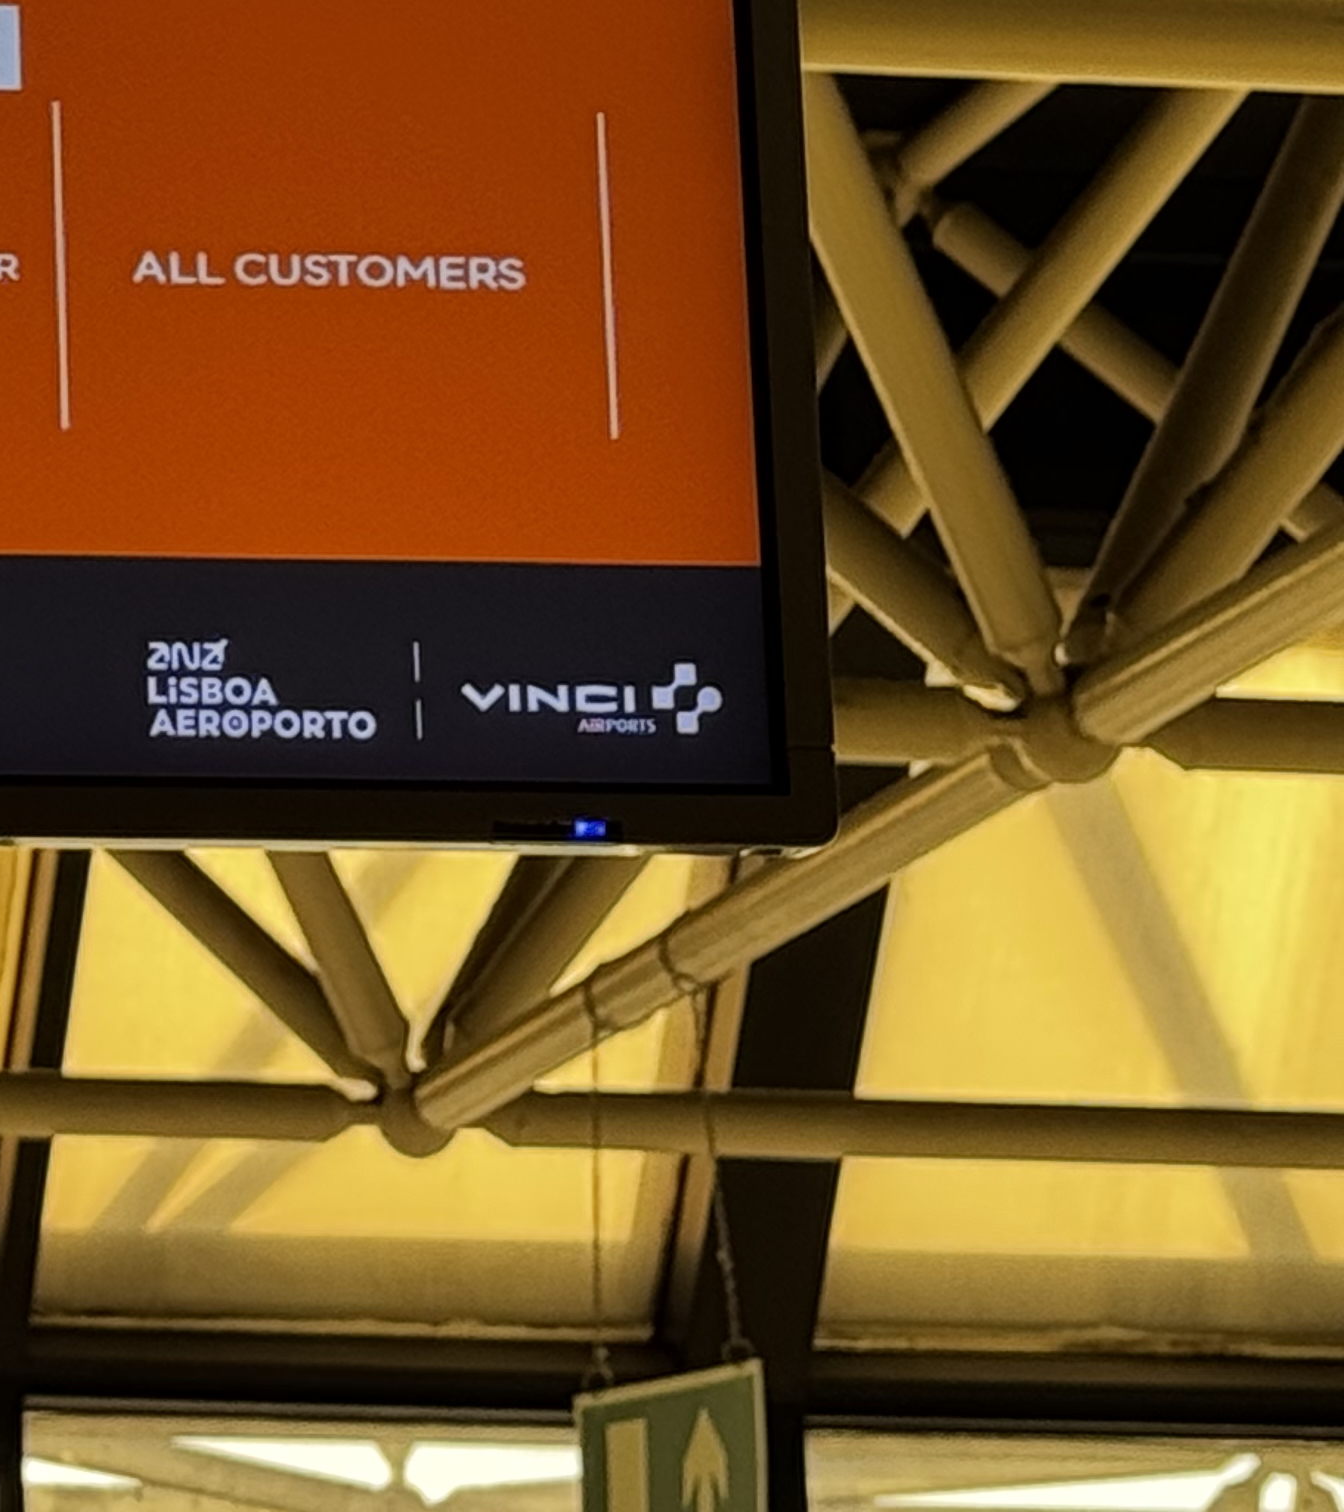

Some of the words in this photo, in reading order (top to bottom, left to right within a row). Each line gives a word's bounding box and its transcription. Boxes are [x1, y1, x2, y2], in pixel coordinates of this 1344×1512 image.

[132, 250, 226, 285] ALL
[233, 253, 528, 291] CUSTOMERS
[460, 683, 637, 714] VINCI
[149, 708, 378, 739] AEROPORTO
[576, 717, 658, 735] AIRPORTS
